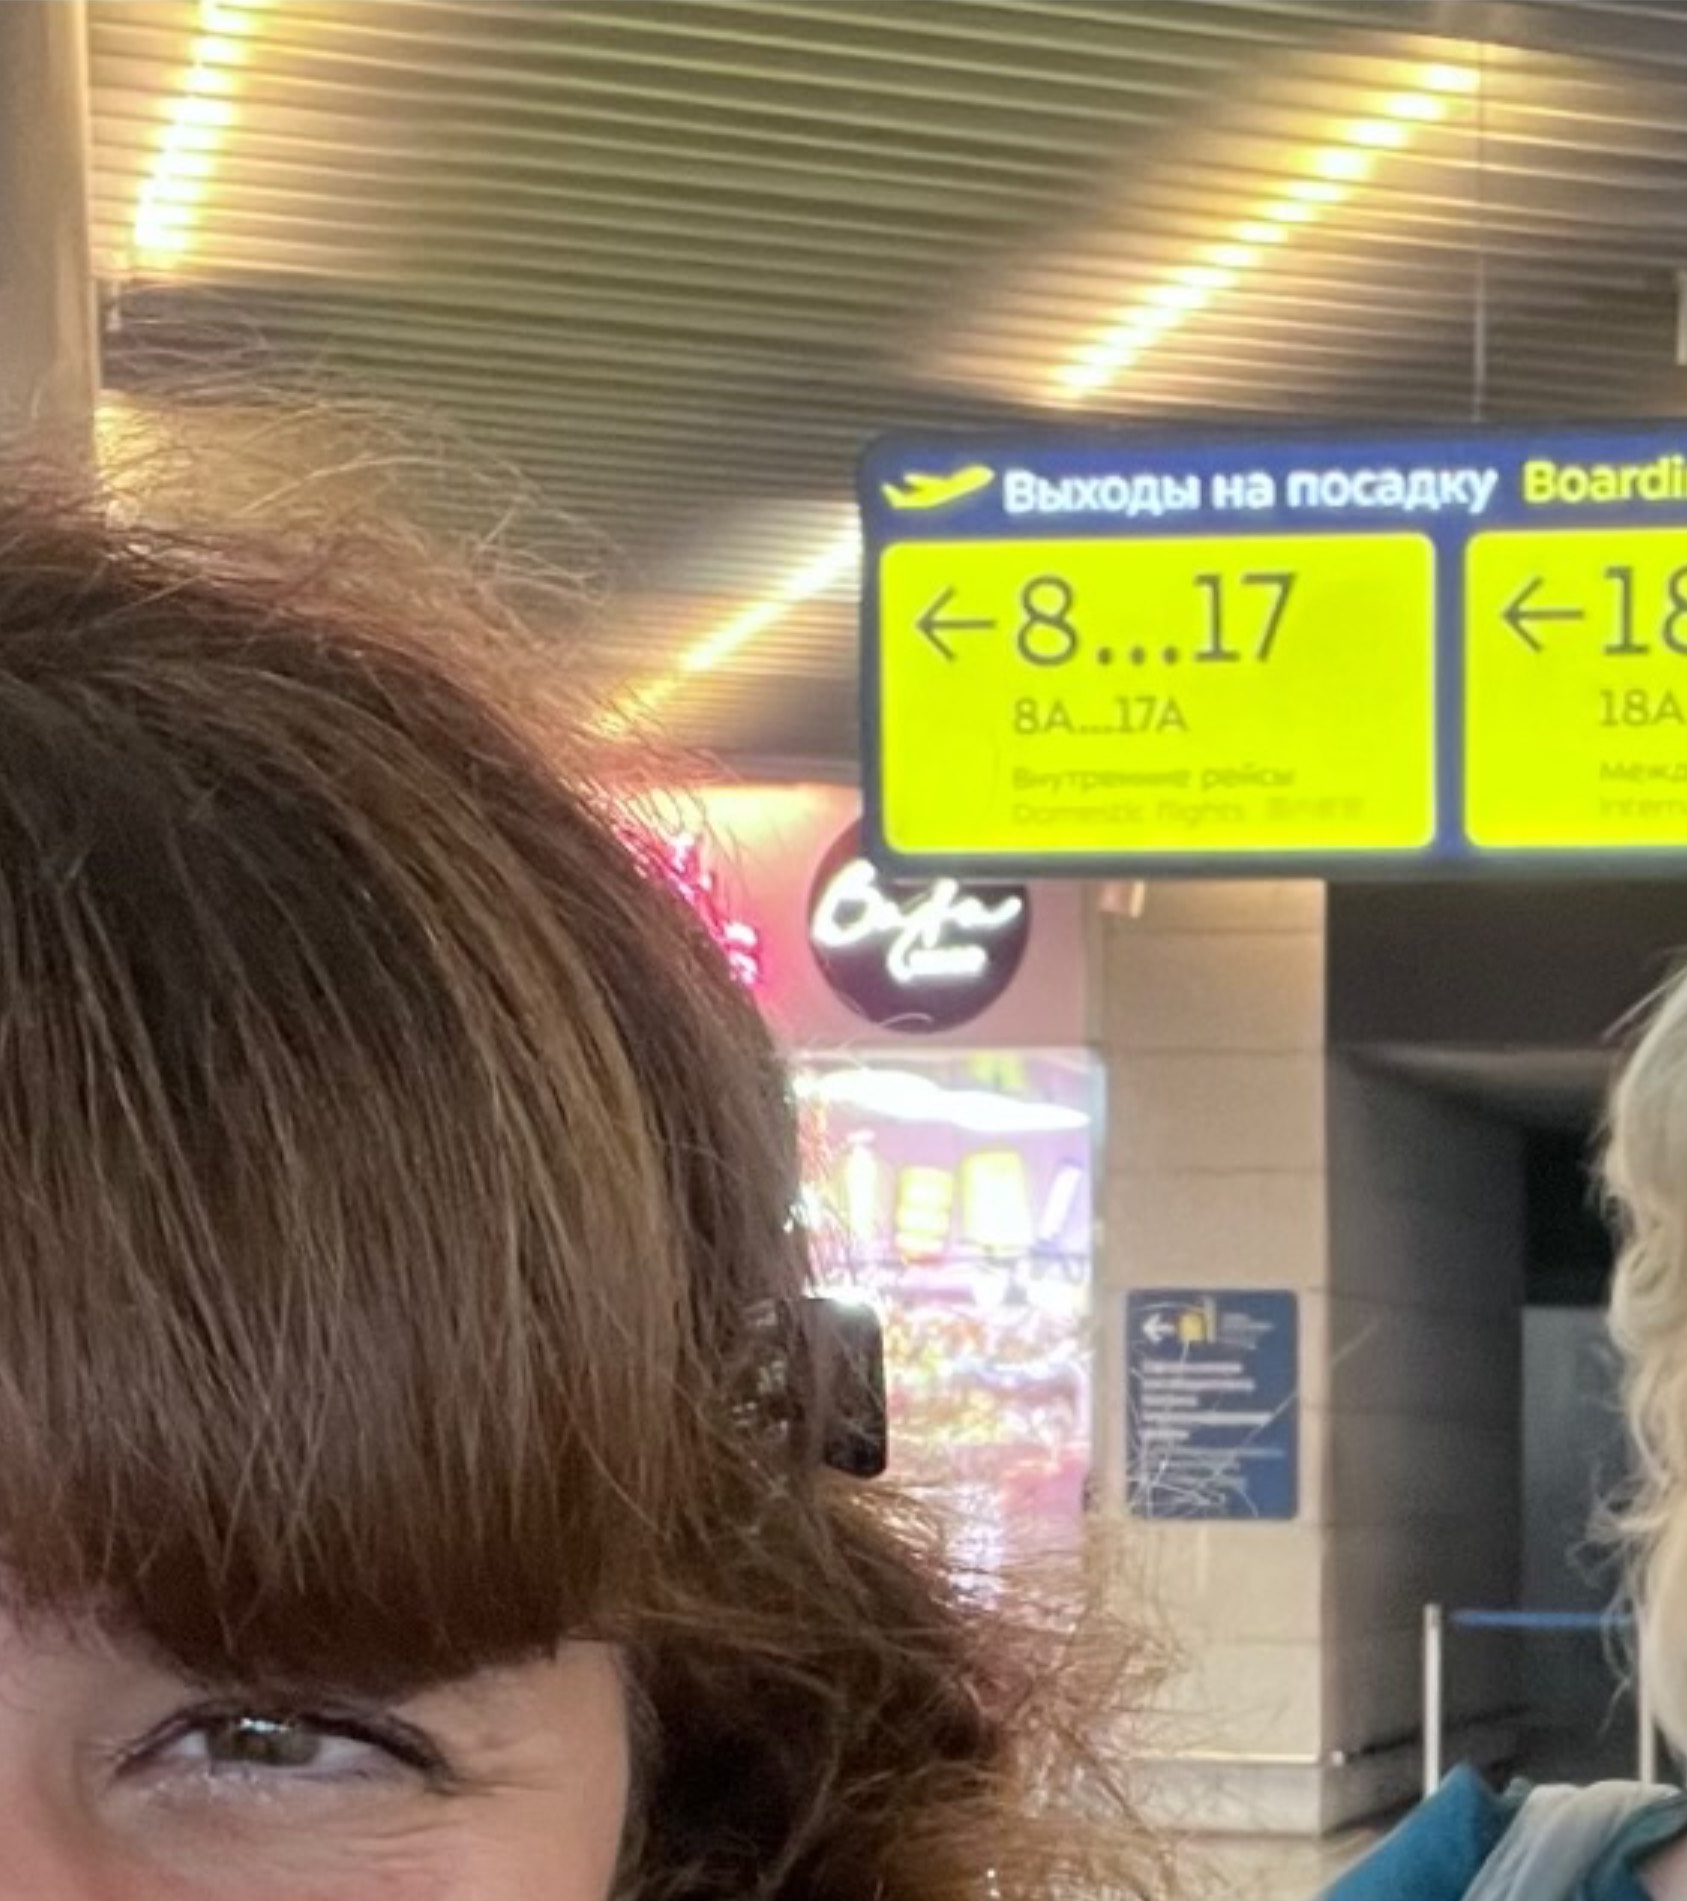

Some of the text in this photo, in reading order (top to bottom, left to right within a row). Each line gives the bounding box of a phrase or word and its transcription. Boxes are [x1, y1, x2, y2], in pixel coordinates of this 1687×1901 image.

[1002, 467, 1499, 515] Выходы на посадку
[1012, 761, 1295, 794] Внутренние рейсы
